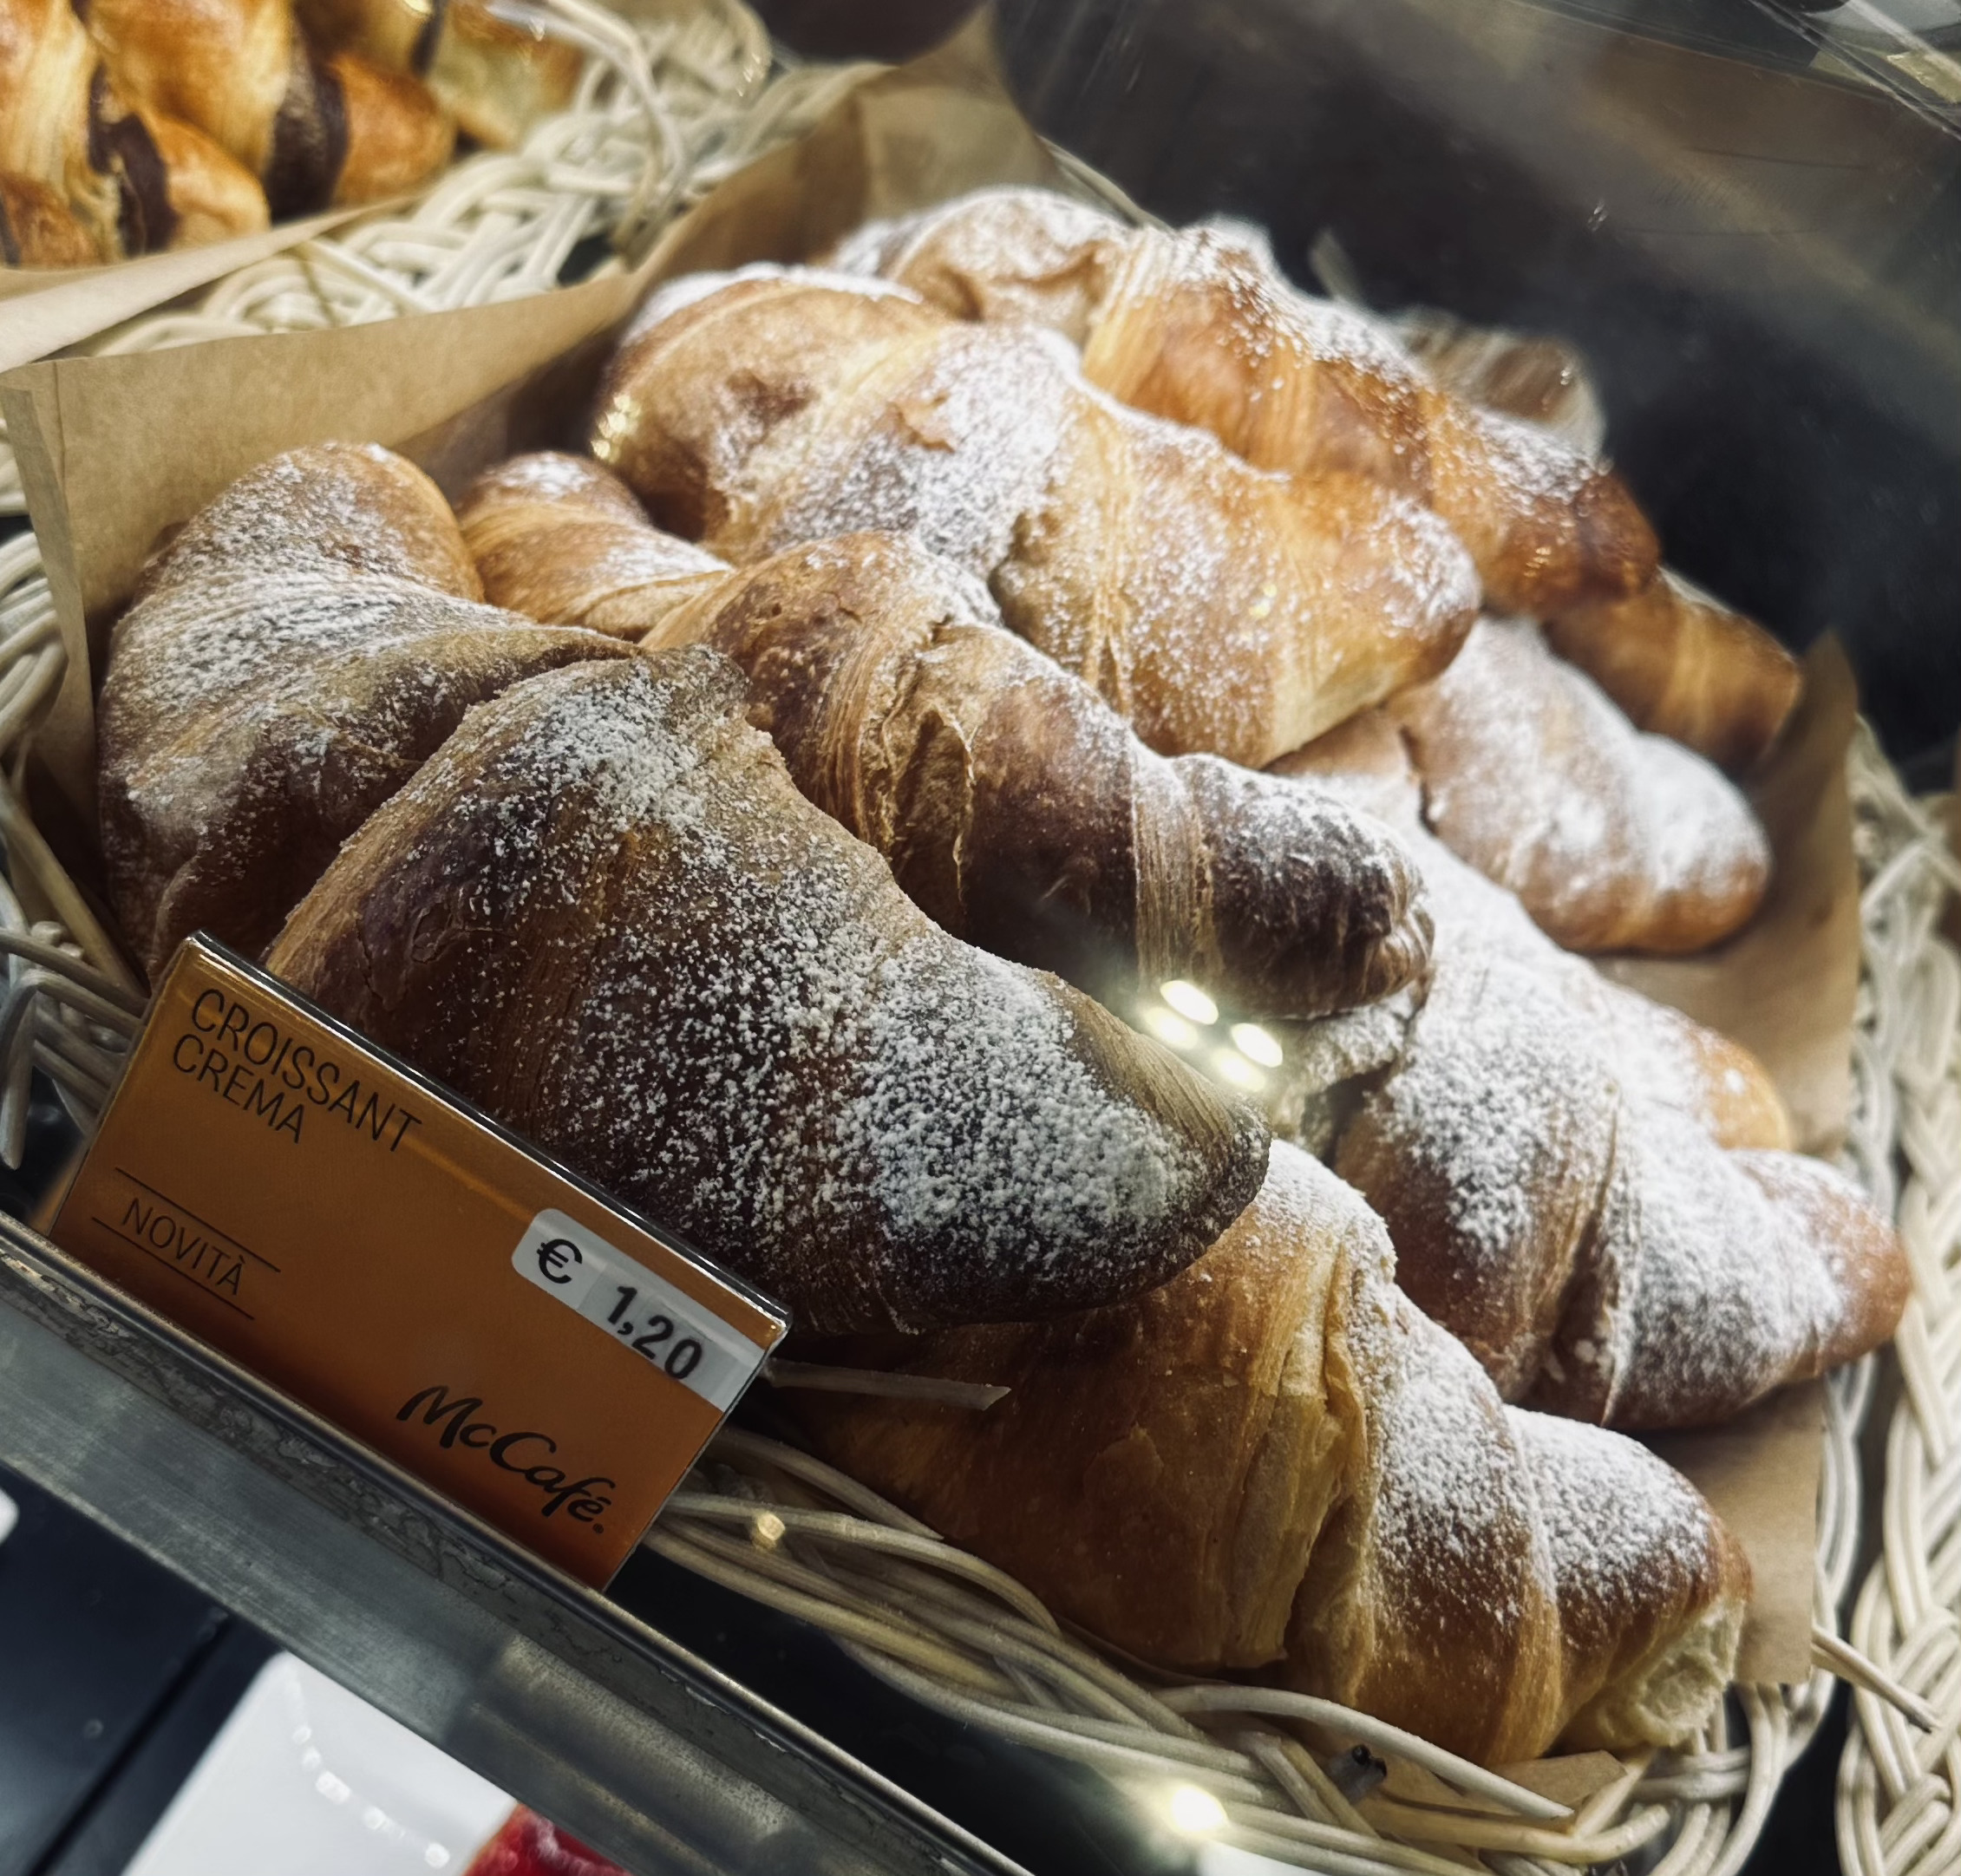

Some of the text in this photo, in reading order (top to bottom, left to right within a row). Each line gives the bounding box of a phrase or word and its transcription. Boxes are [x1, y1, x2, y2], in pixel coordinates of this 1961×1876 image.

[173, 1034, 304, 1144] CREMA
[192, 989, 422, 1152] CROISSANT
[121, 1198, 245, 1296] NOVITÀ
[536, 1239, 703, 1380] € 1,20
[395, 1385, 616, 1522] McCafé
